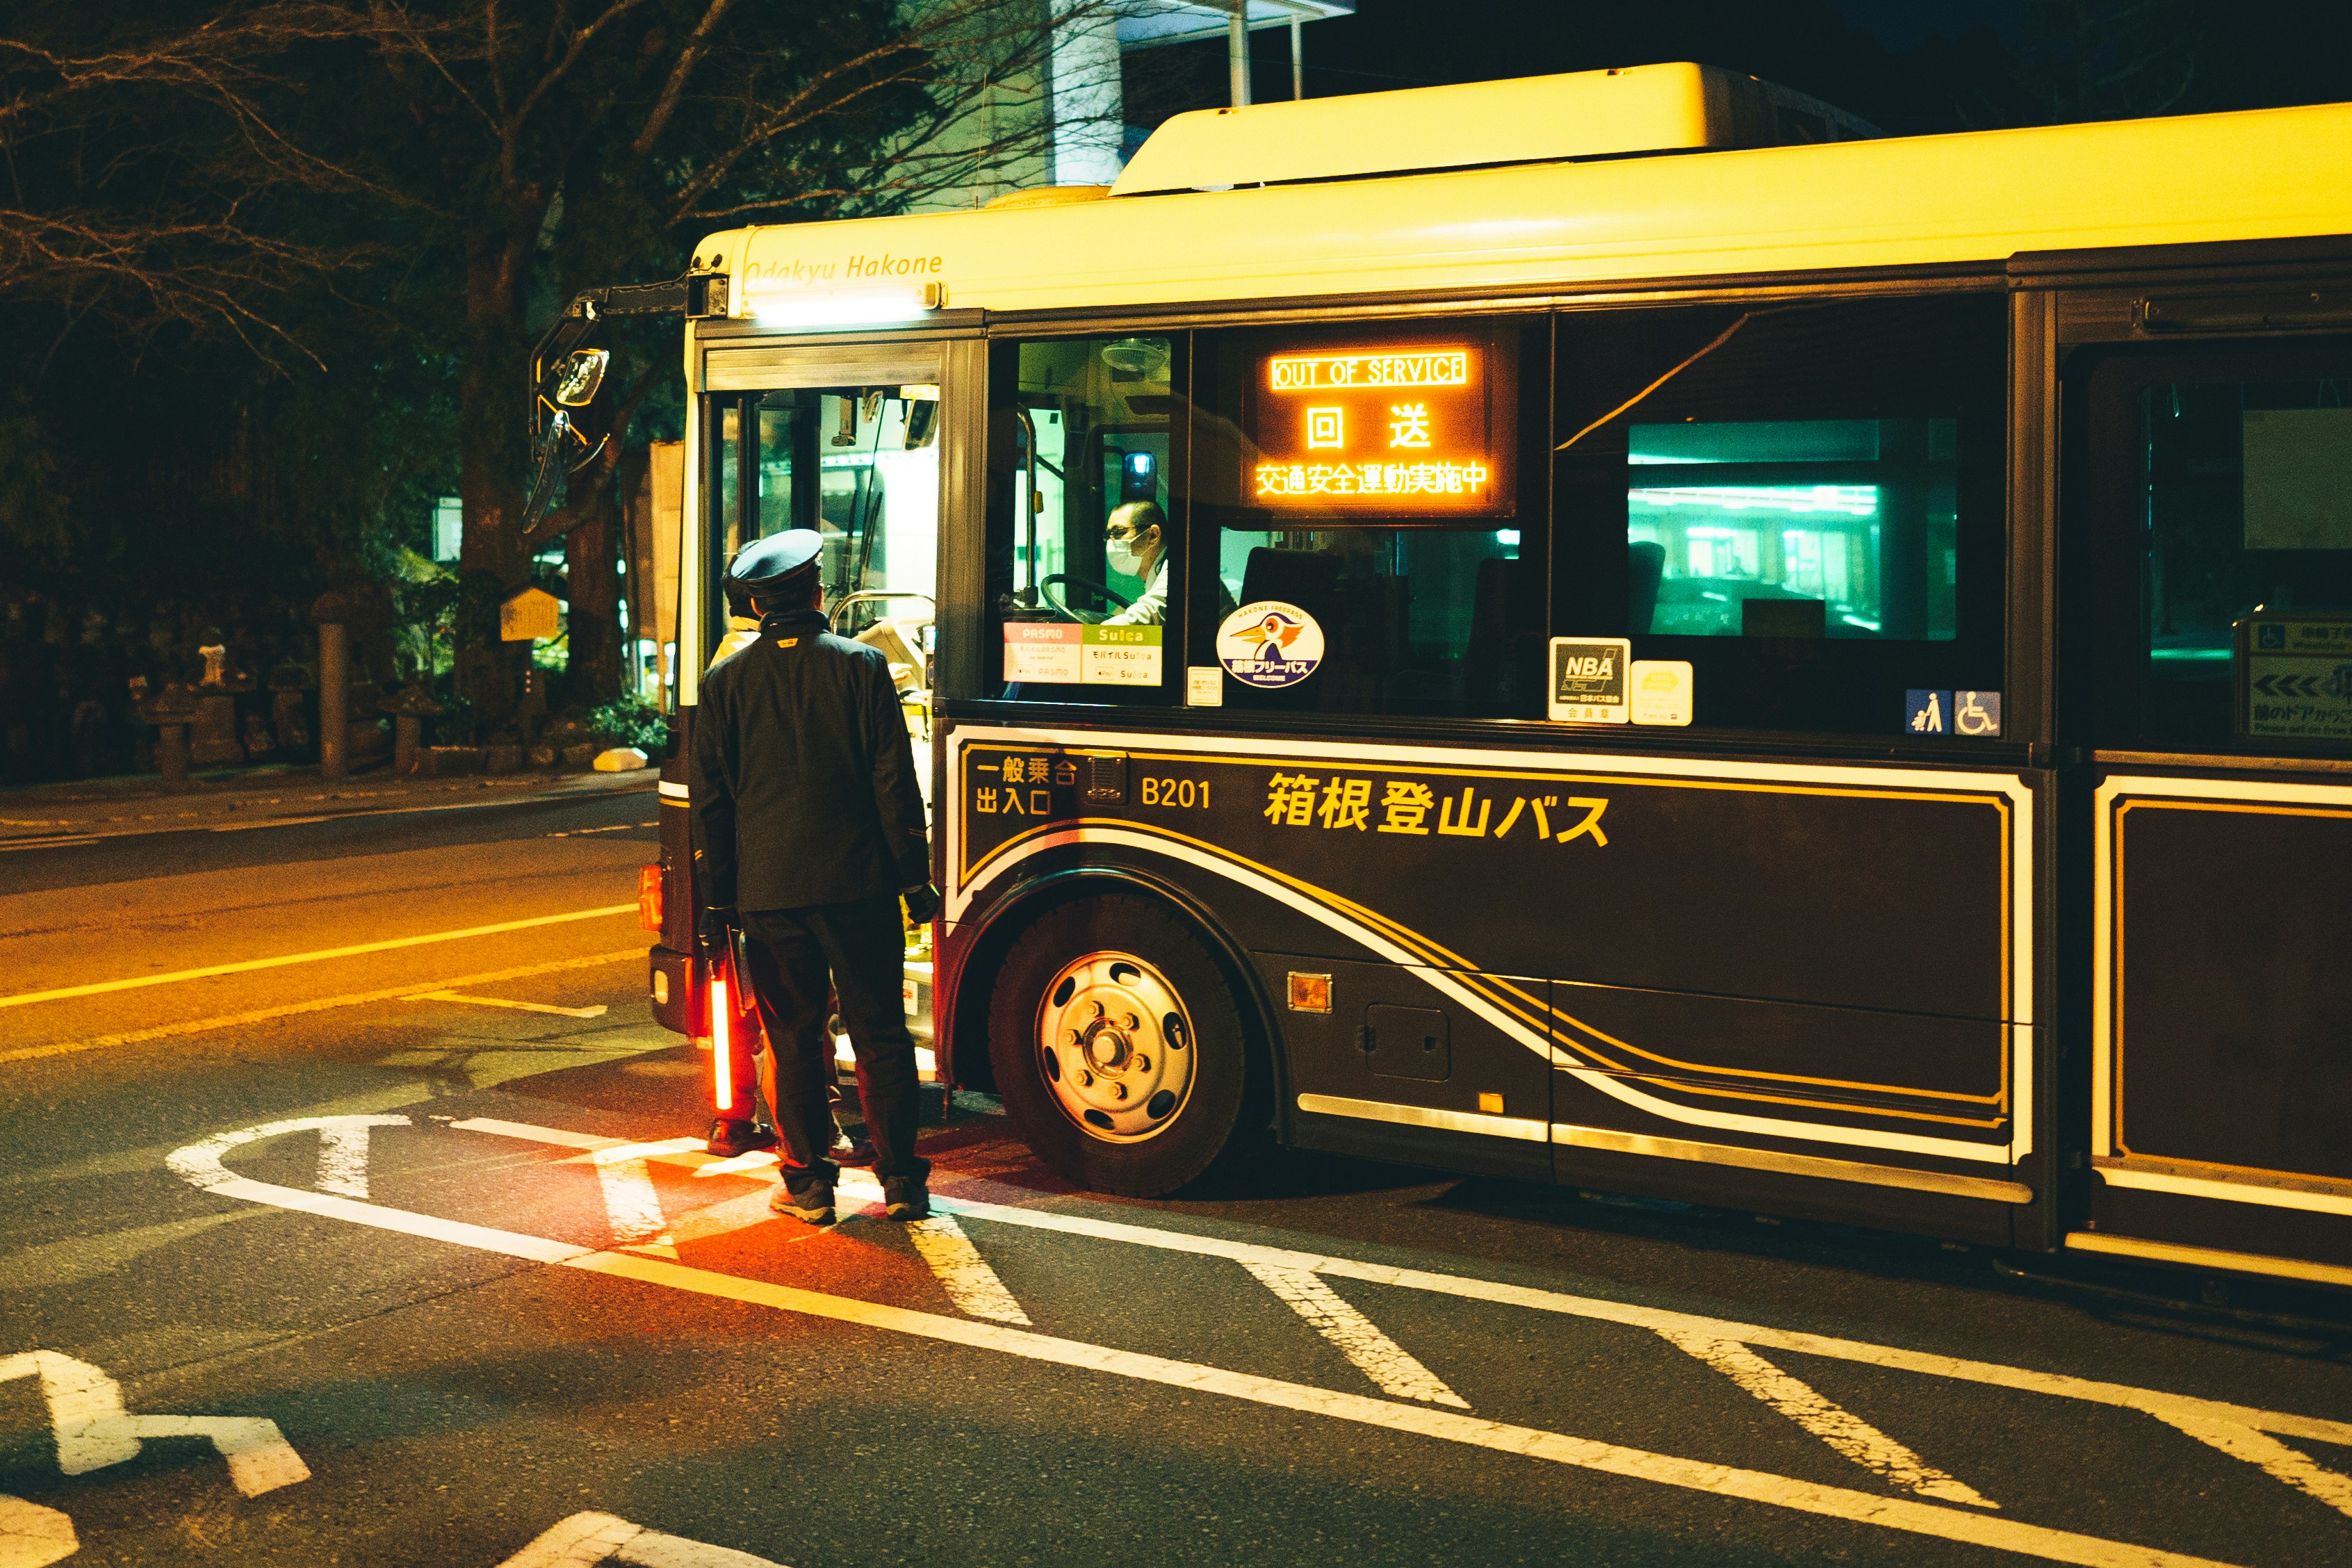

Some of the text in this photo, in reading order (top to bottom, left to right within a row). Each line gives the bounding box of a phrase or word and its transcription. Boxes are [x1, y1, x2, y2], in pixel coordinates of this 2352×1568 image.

[744, 254, 942, 286] Odakyu Hakone
[1276, 357, 1462, 386] OUT OF SERVICE
[1256, 461, 1486, 495] 交通安全運動実施中
[1238, 605, 1303, 619] HAKONE FREEPASS
[1022, 628, 1063, 639] PASMO
[1099, 629, 1143, 641] Suica
[1038, 668, 1068, 676] PASMO
[1231, 660, 1308, 674] 箱根フリーパス
[1565, 657, 1613, 676] NBA
[977, 756, 1077, 786] 一般乗合
[977, 787, 1051, 815] 出入口
[1142, 777, 1209, 809] B201
[1264, 771, 1609, 847] 箱根登山バス
